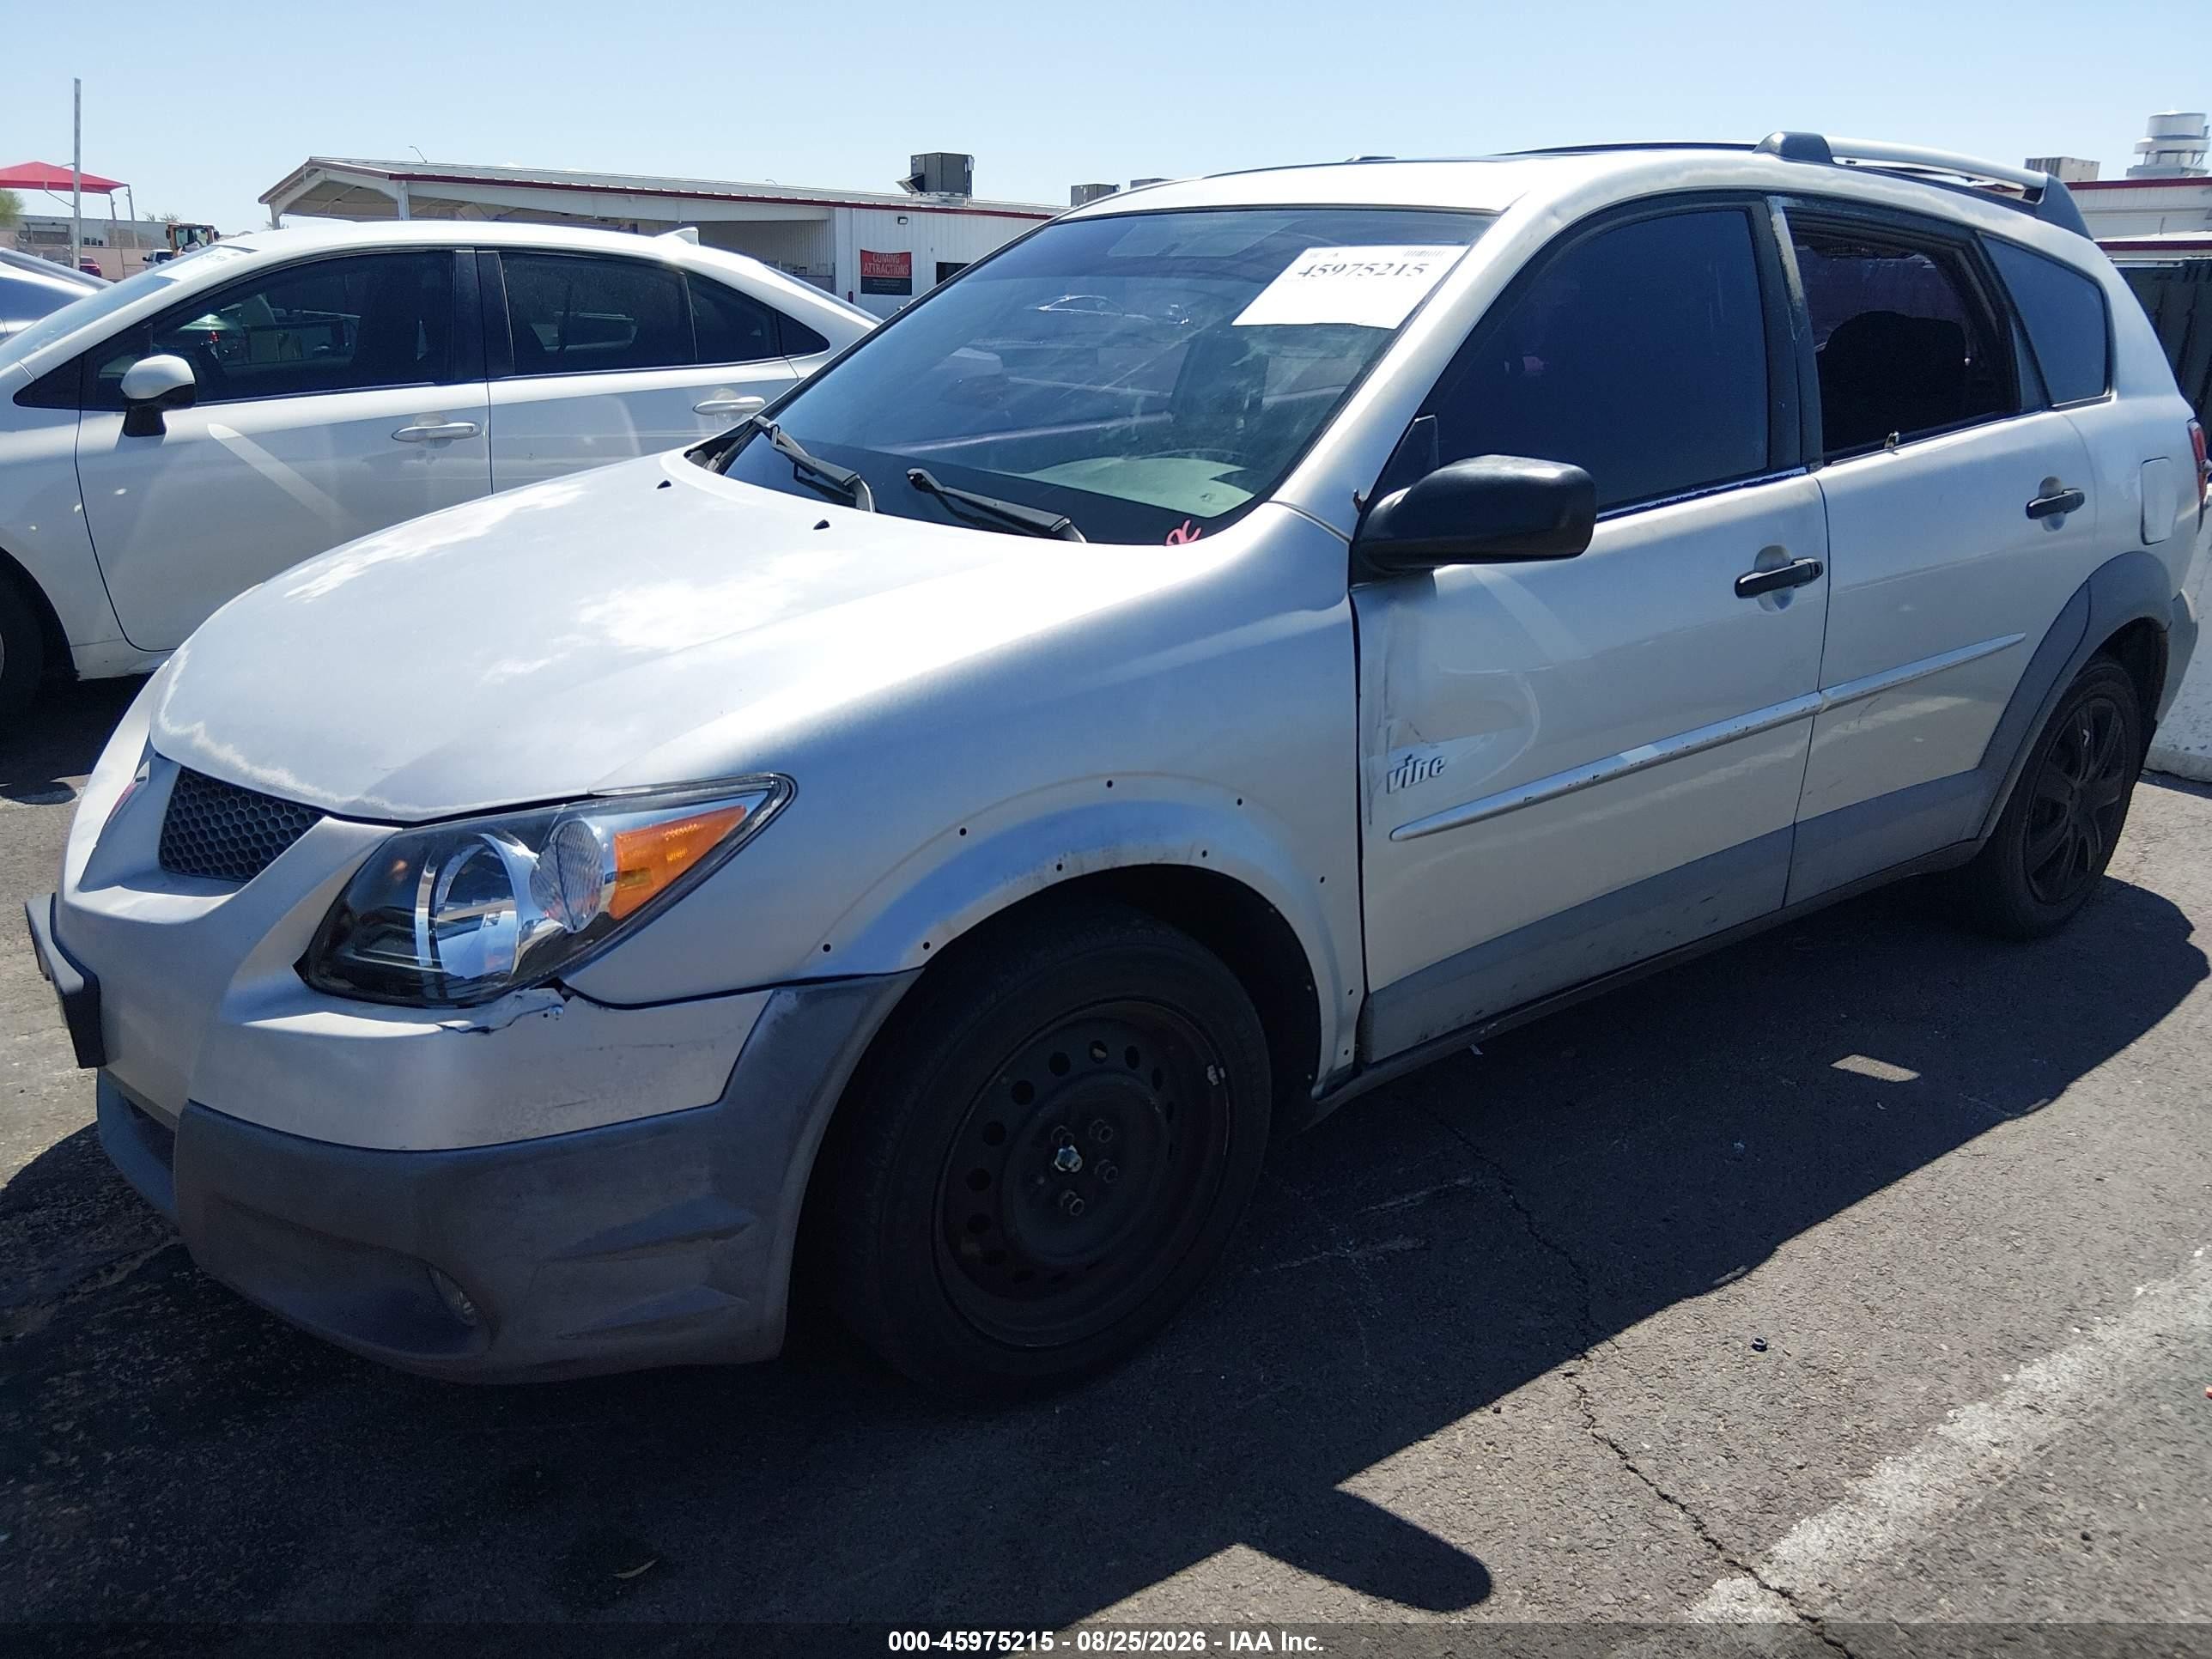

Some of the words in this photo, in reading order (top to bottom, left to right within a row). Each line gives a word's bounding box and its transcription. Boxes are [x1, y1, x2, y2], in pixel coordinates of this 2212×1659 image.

[872, 253, 901, 264] COMING
[864, 263, 909, 276] ATTRACTIONS
[1297, 262, 1431, 277] 45975215
